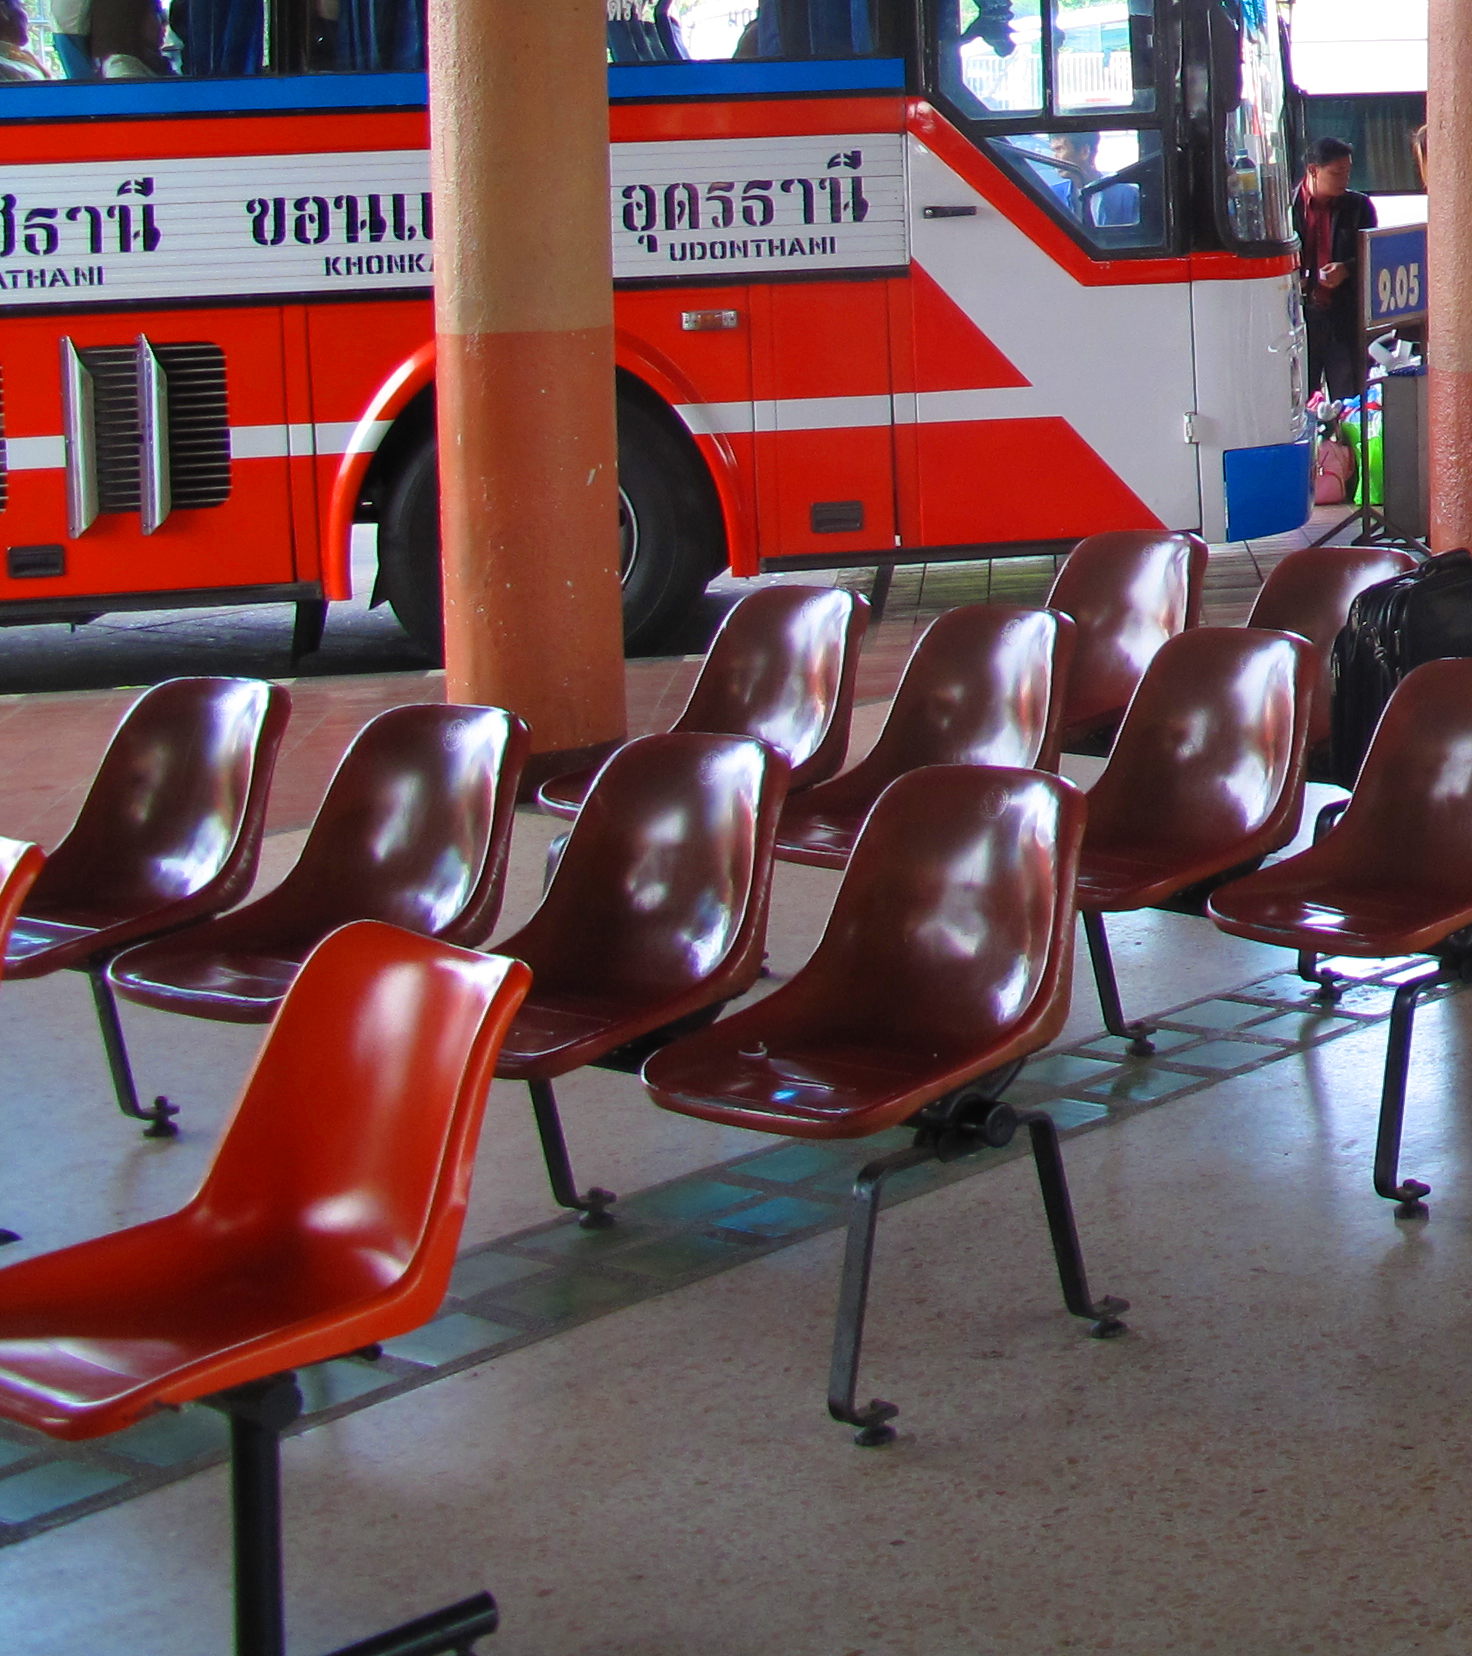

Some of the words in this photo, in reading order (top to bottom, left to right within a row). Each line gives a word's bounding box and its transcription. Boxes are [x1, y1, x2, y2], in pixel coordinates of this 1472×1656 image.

[622, 150, 869, 253] อุดรธานี
[325, 253, 433, 277] KHONK
[670, 236, 838, 261] UDONTHANI
[1378, 263, 1419, 313] 9.05
